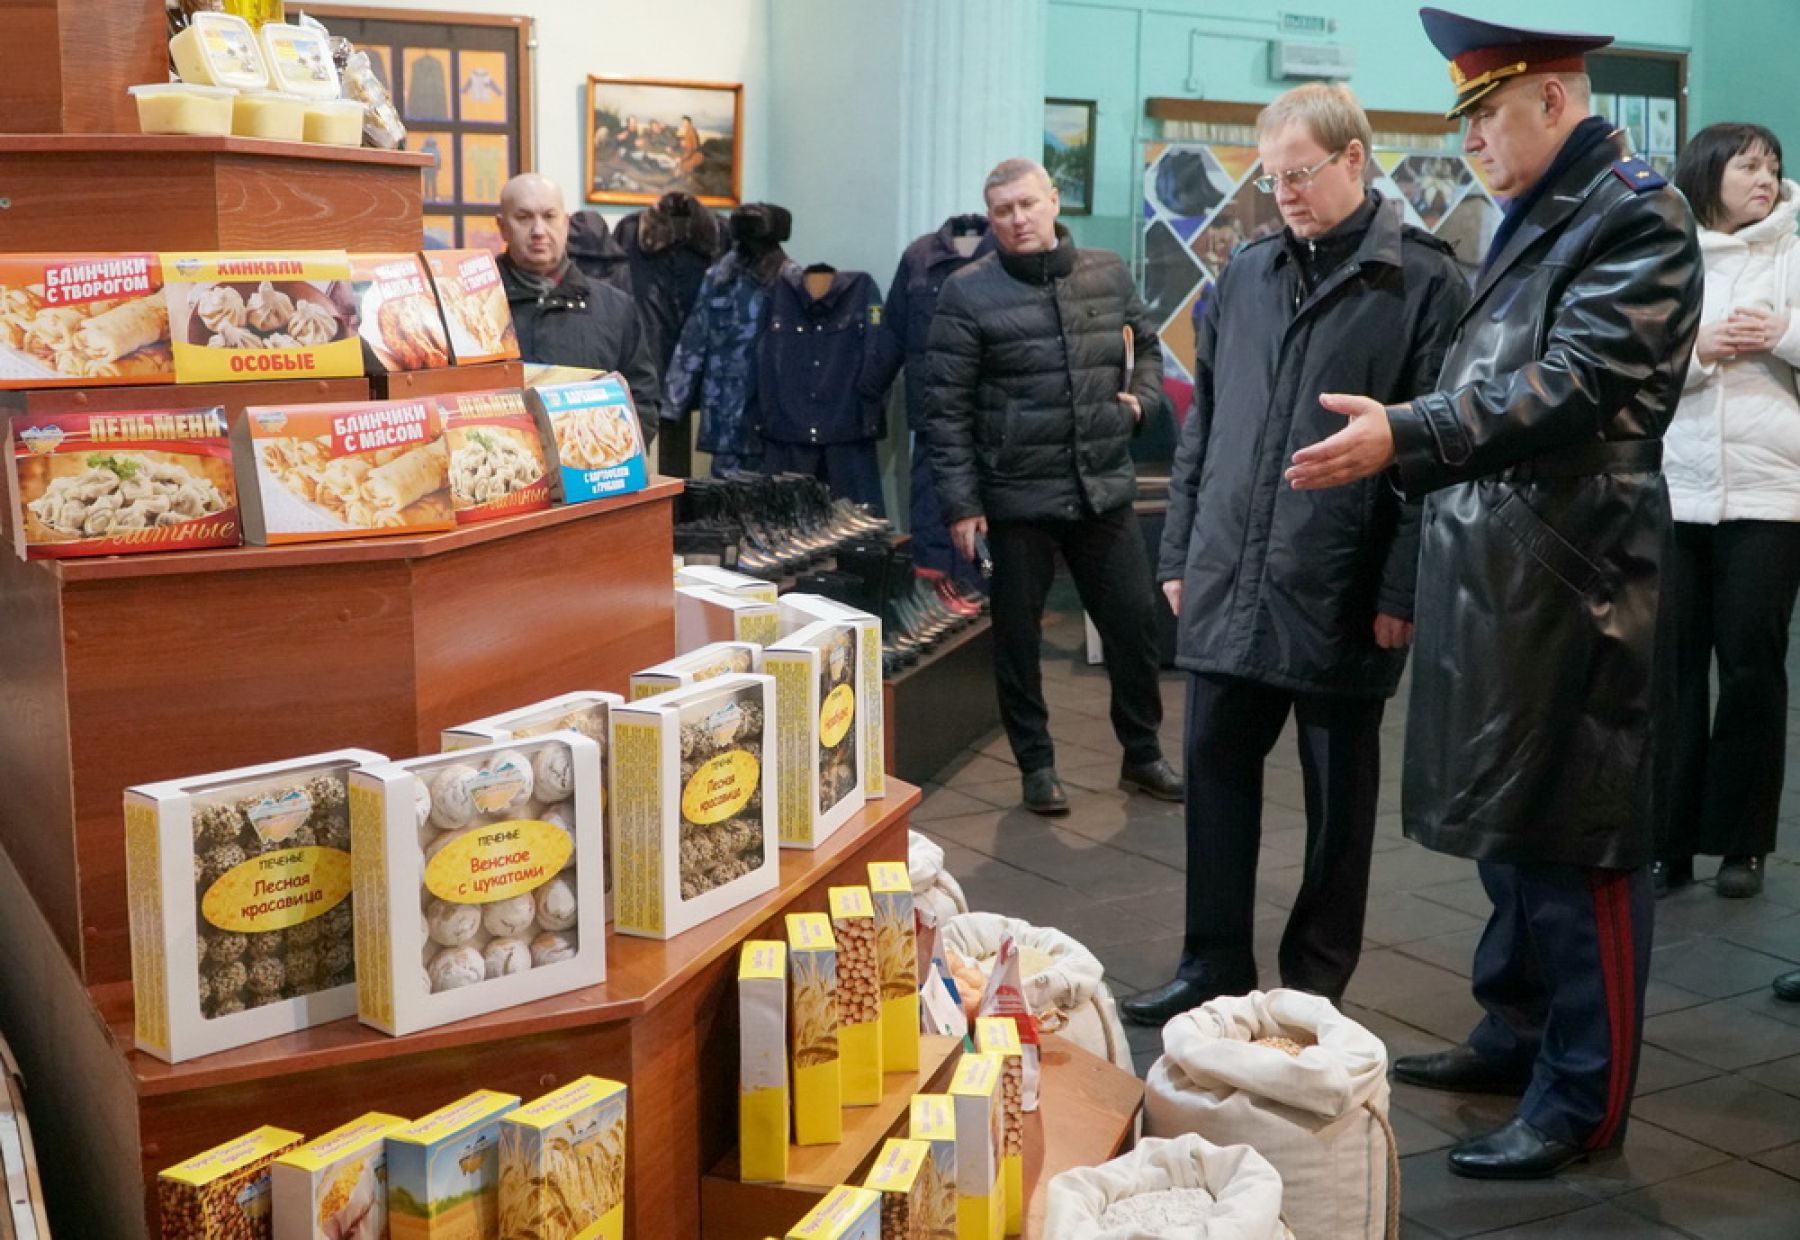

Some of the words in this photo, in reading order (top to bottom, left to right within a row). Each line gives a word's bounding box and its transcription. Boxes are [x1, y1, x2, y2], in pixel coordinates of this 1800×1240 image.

[46, 257, 147, 287] БЛИНЧИКИ
[217, 260, 304, 276] ХИНКАЛИ
[46, 287, 59, 302] С
[61, 275, 149, 301] ТВОРОГОМ
[230, 352, 316, 372] ОСОБЫЕ
[88, 413, 222, 443] ПЕЛЬМЕНИ
[333, 404, 427, 437] БЛИНЧИКИ
[344, 434, 358, 453] С
[359, 422, 425, 449] МЯСОМ
[477, 828, 521, 847] ПЕЧЕНЬЕ
[257, 851, 305, 871] ПЕЧЕНЬЕ
[470, 849, 531, 874] Венское
[252, 873, 312, 897] Лесная
[458, 883, 467, 896] с
[473, 865, 545, 893] цукатами
[240, 888, 324, 921] красавица
